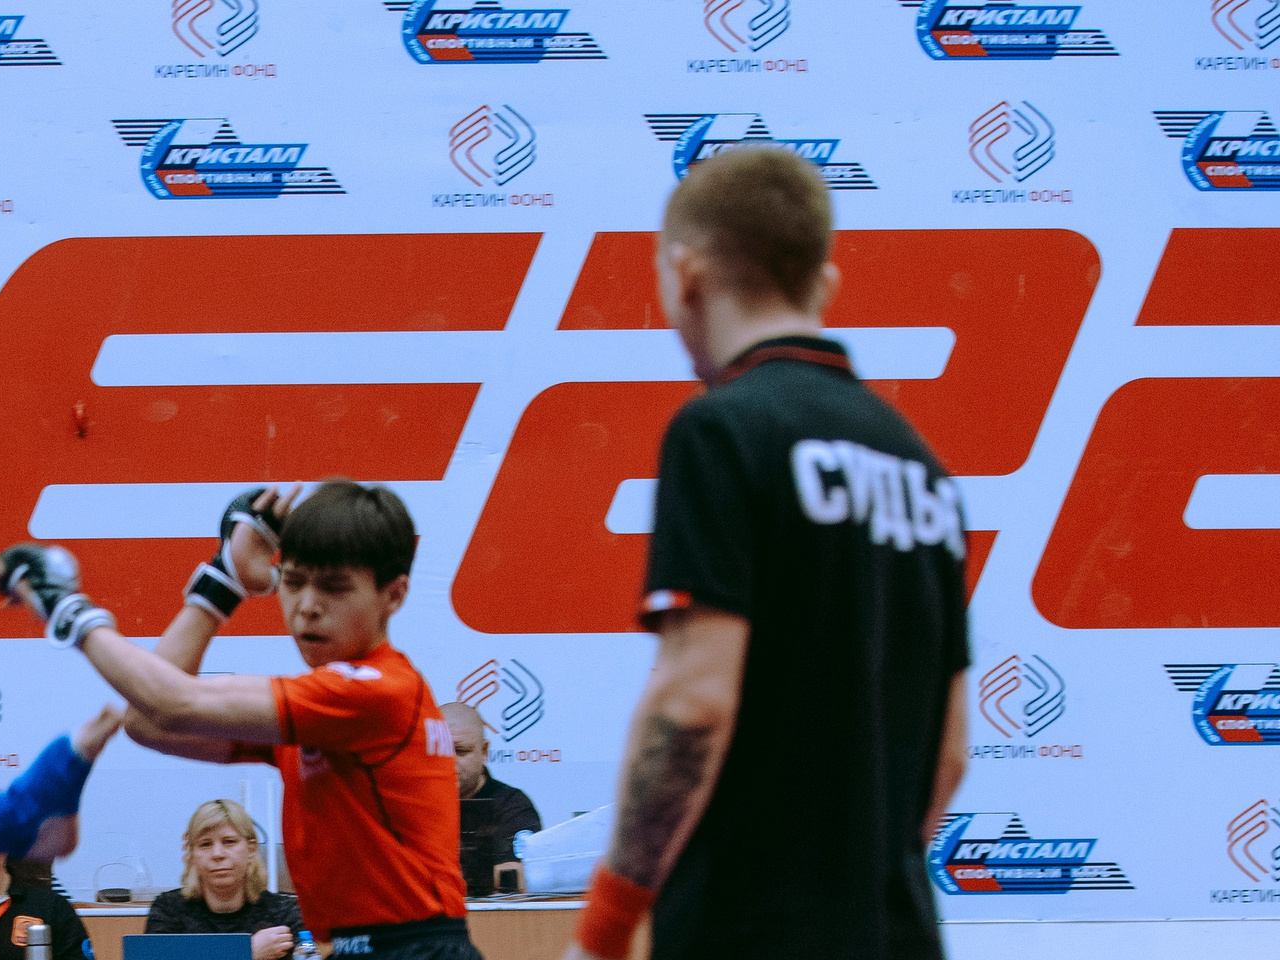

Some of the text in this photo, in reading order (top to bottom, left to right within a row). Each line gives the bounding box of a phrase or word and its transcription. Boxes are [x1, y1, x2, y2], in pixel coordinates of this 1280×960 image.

[427, 11, 562, 31] КРИСТАЛЛ
[940, 7, 1075, 27] КРИСТАЛЛ
[155, 63, 277, 78] КАРЕЛИН ФОНД
[687, 58, 808, 73] КАРЕЛИН ФОНД
[1195, 56, 1268, 71] КАРЕЛИН
[165, 146, 300, 166] КРИСТАЛЛ
[432, 192, 554, 208] КАРЕЛИН ФОНД
[952, 189, 1073, 204] КАРЕЛИН ФОНД
[516, 749, 561, 763] ФОНД
[1038, 745, 1084, 759] ФОНД
[955, 841, 1090, 861] КРИСТАЛЛ
